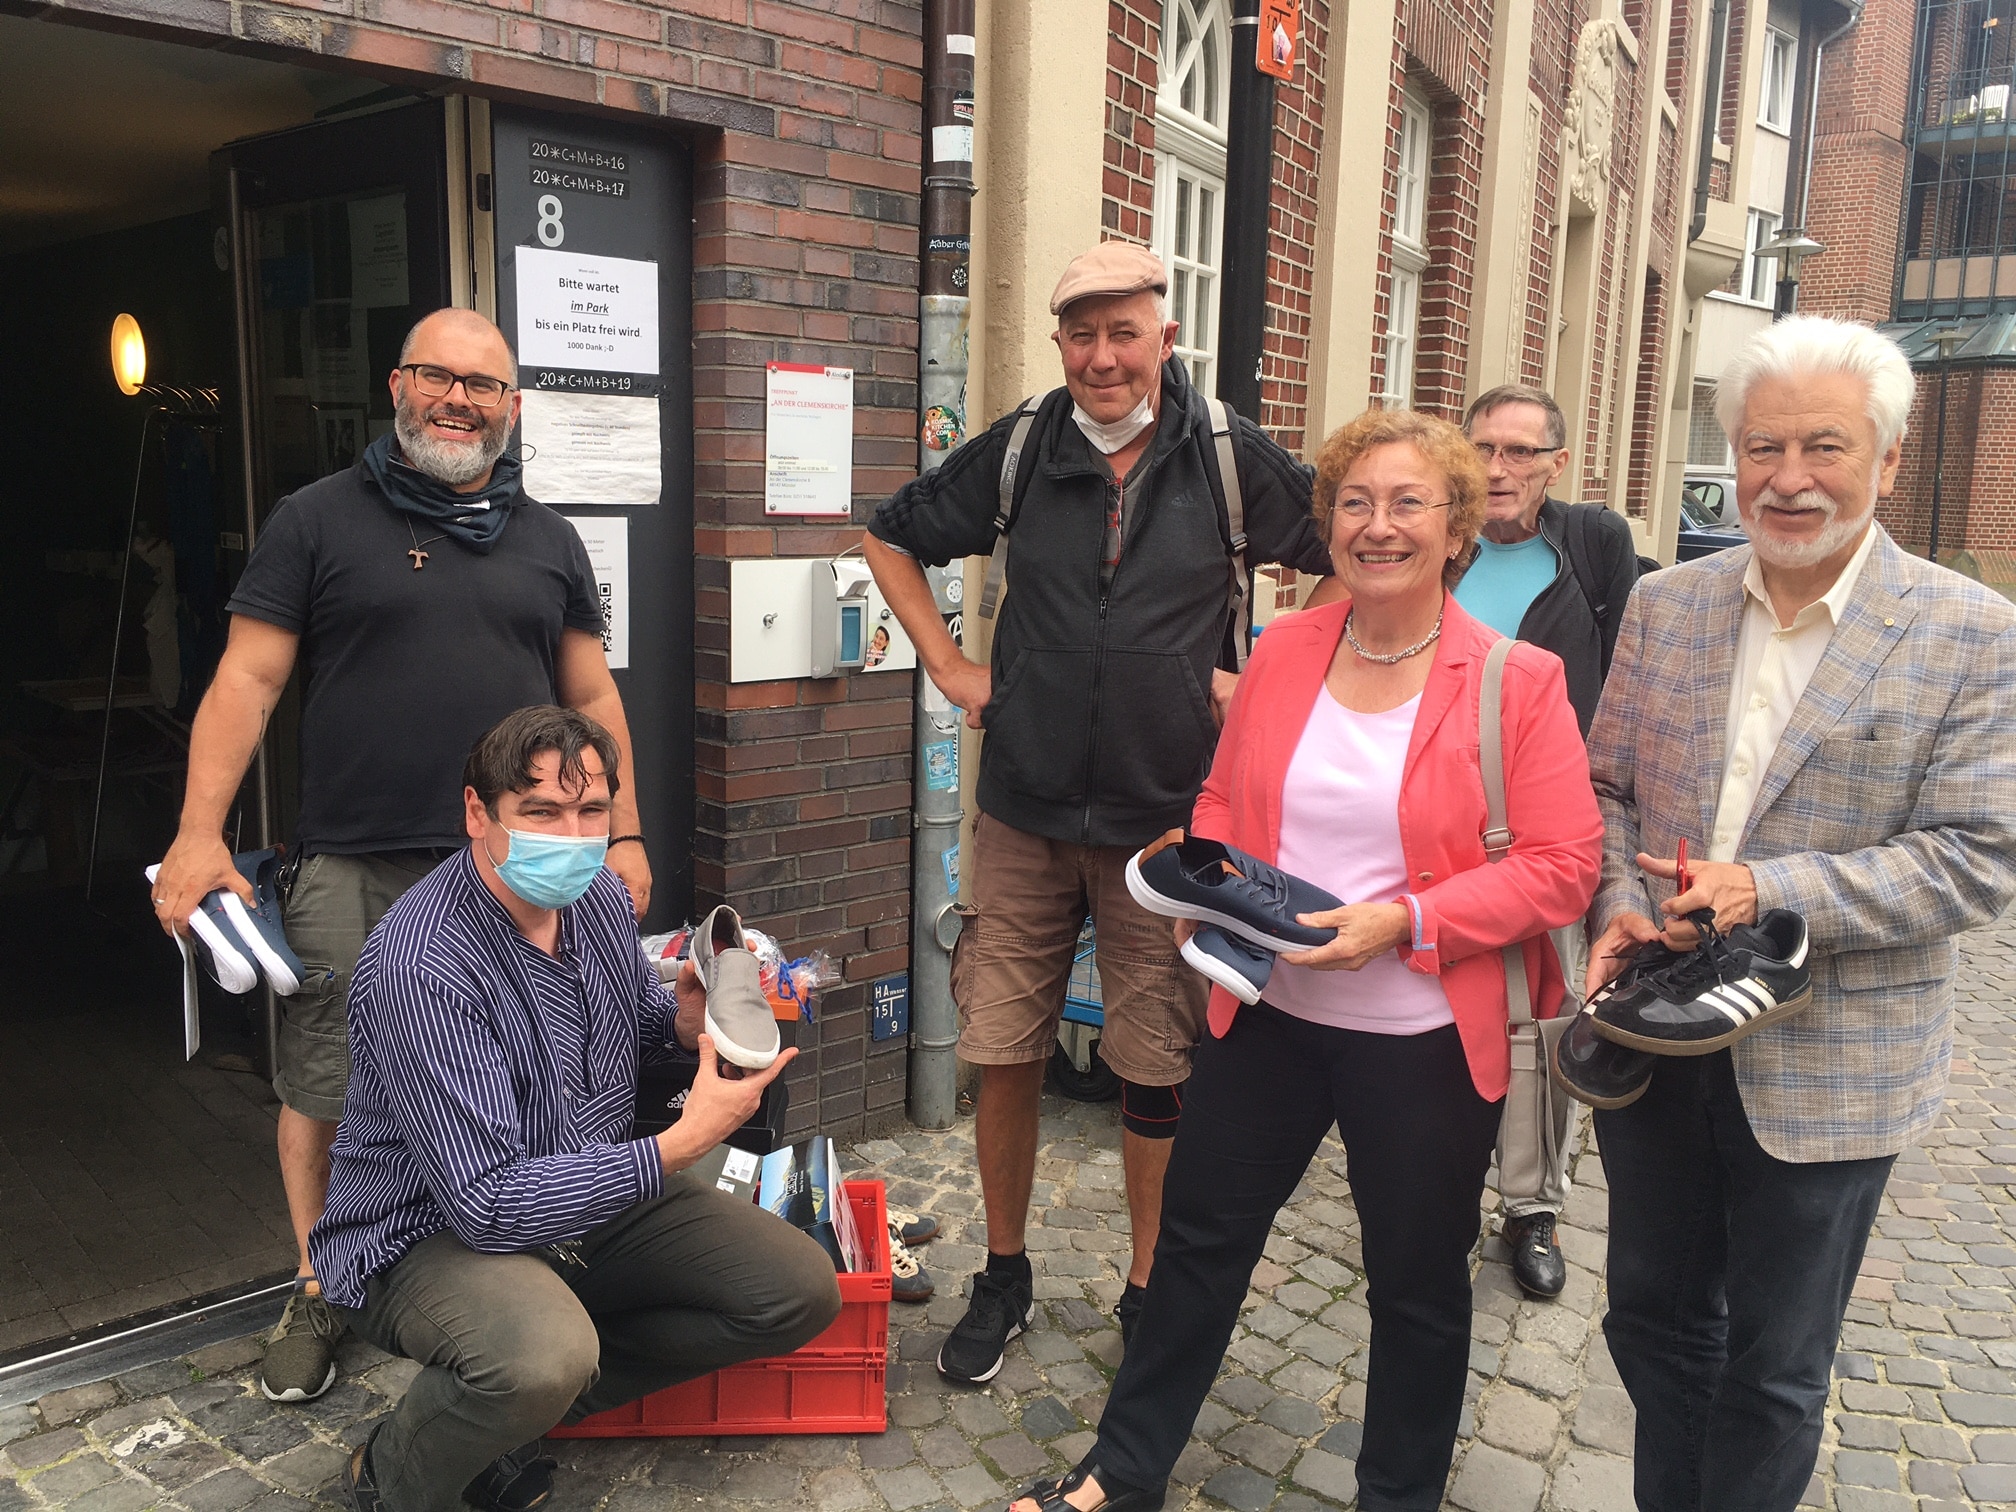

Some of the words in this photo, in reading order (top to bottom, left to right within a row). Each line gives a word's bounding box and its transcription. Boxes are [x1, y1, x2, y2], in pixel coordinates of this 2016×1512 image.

[538, 194, 564, 248] 8
[559, 278, 584, 290] Bitte
[586, 281, 620, 294] wartet
[571, 301, 584, 312] im
[586, 302, 609, 314] Park
[535, 319, 551, 330] bis
[553, 321, 569, 332] ein
[572, 320, 596, 334] Platz
[599, 324, 616, 336] frei
[567, 341, 584, 350] 1000
[585, 343, 603, 352] Dank
